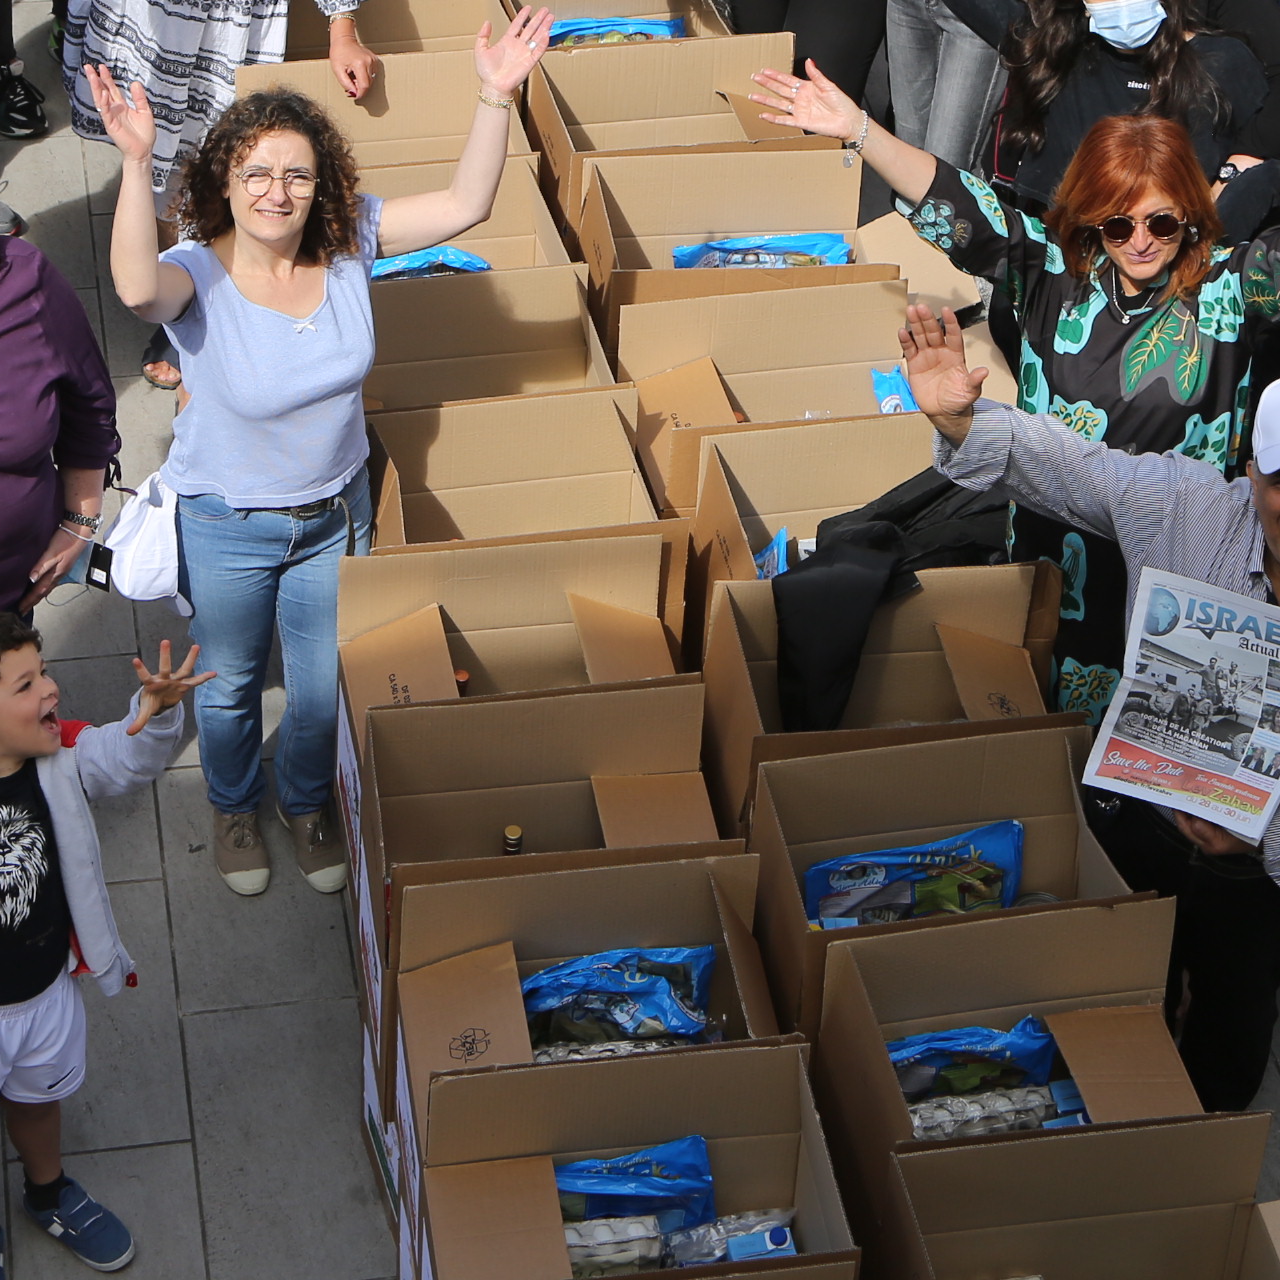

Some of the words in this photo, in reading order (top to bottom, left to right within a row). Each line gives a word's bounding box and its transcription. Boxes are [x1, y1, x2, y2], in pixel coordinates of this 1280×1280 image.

[1140, 712, 1152, 720] 100
[1153, 717, 1168, 726] ANS
[1169, 722, 1180, 730] DE
[1180, 726, 1189, 734] LA
[1191, 729, 1230, 750] CRÉATION
[1151, 724, 1162, 732] DE
[1163, 728, 1172, 736] LA
[1173, 731, 1209, 750] HAGANAH
[1103, 751, 1131, 768] Save
[1134, 758, 1152, 771] the
[1153, 762, 1185, 777] Date
[1181, 779, 1262, 815] LevZahav
[1198, 799, 1210, 807] 28
[1211, 804, 1223, 812] au
[1223, 806, 1237, 817] 30
